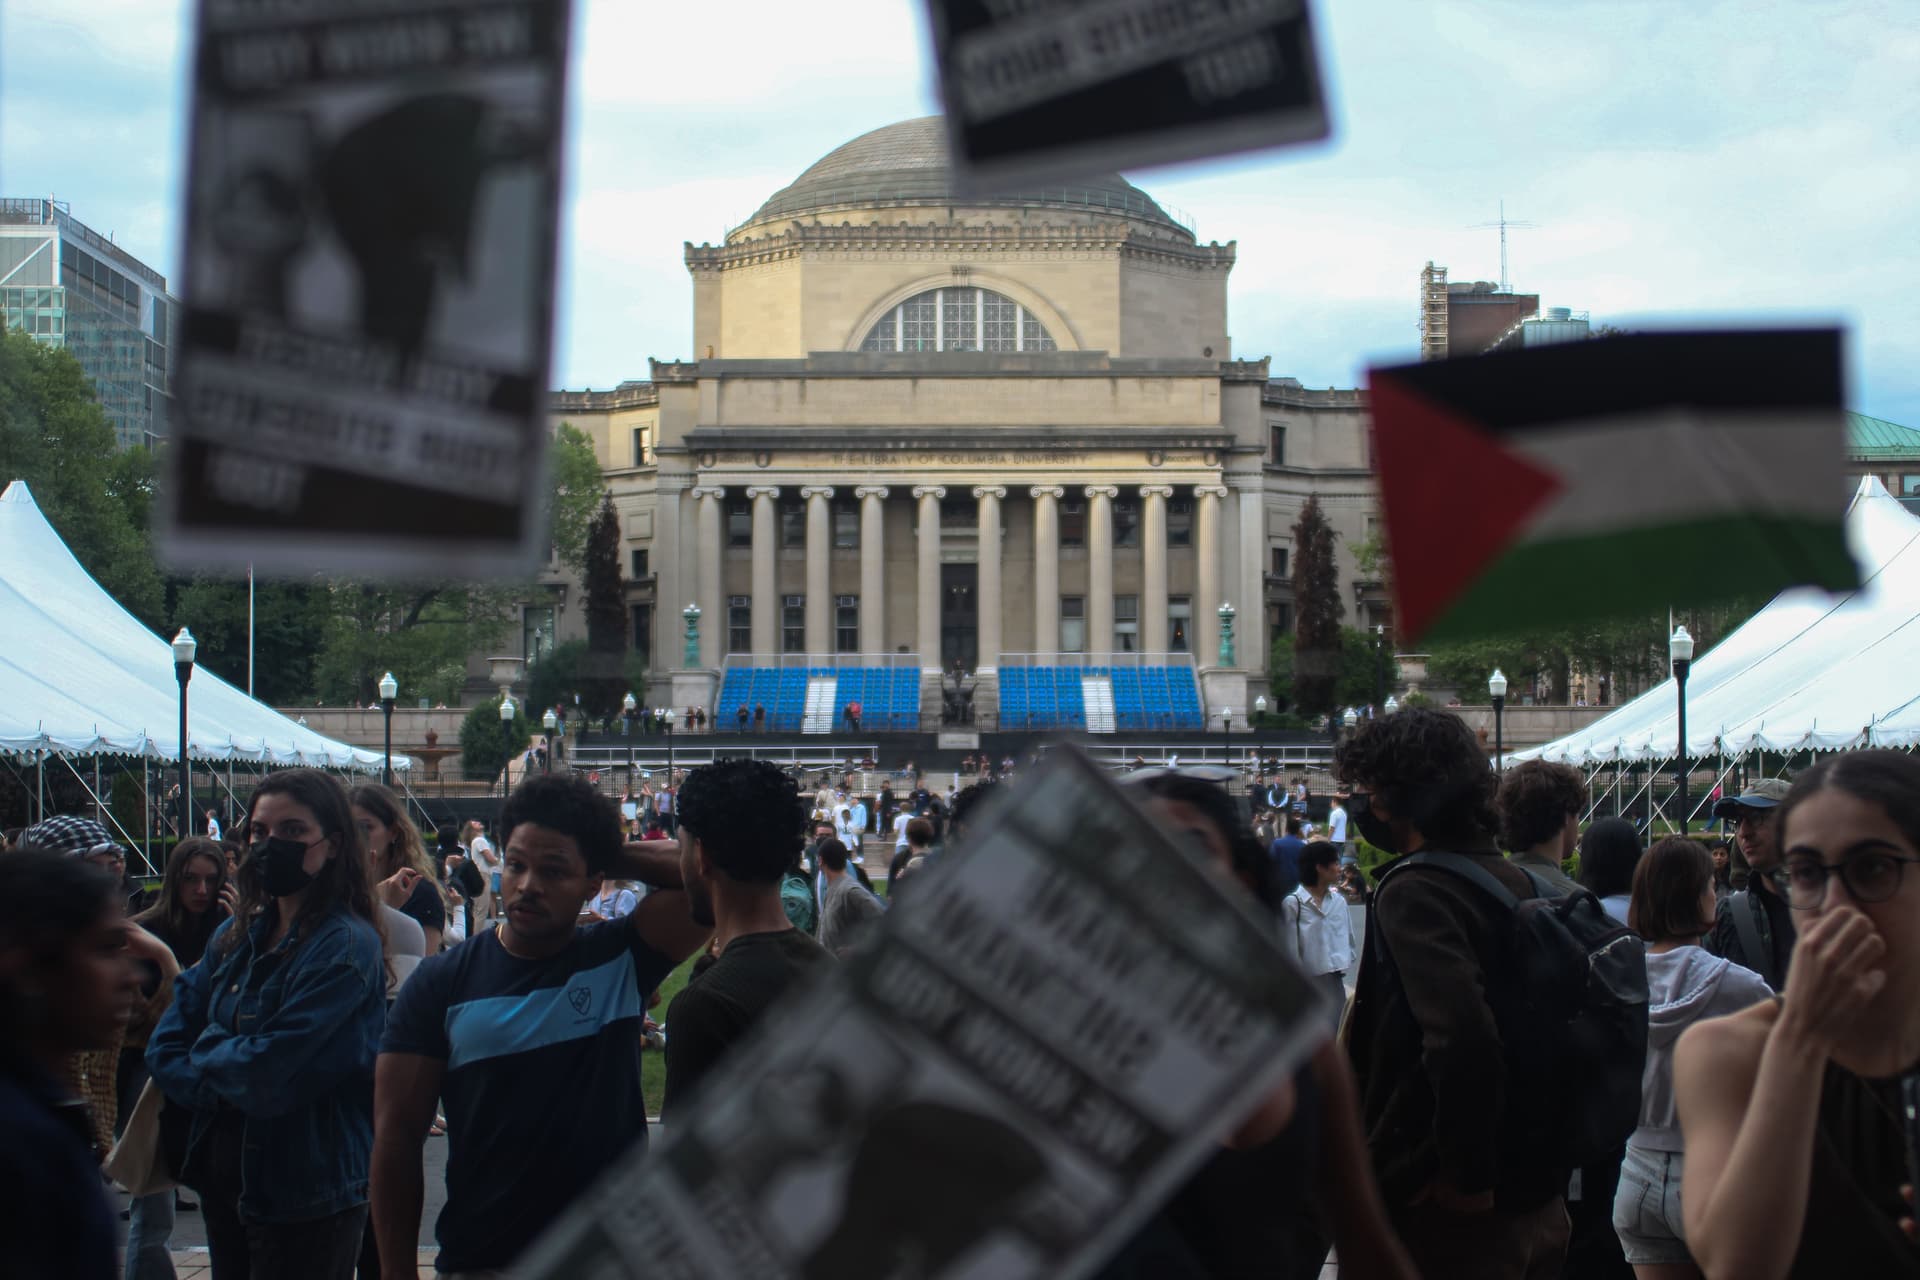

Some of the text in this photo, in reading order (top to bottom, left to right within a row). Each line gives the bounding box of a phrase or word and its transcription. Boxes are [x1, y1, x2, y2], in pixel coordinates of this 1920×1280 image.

[832, 454, 856, 465] THE
[920, 454, 936, 465] OF
[943, 454, 1008, 465] COLUMBIA
[1014, 454, 1087, 465] UNIVERSITY
